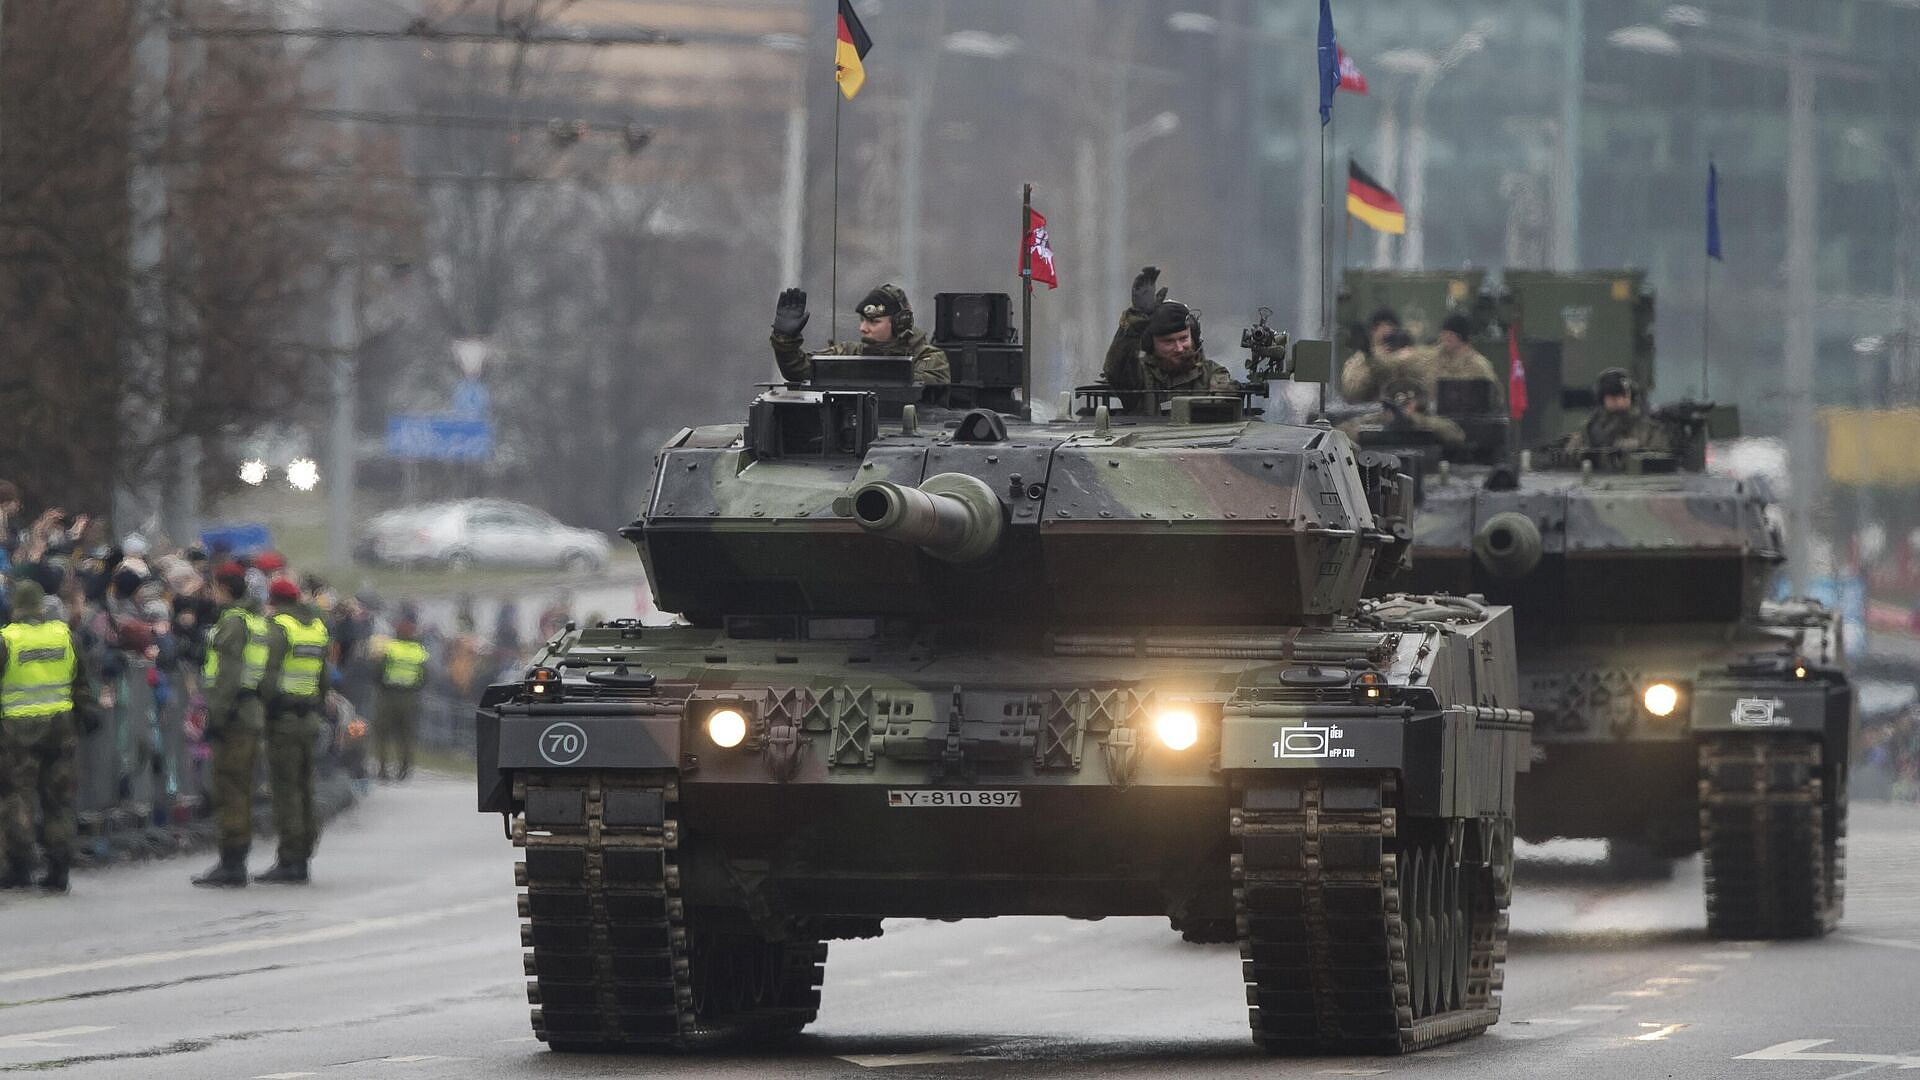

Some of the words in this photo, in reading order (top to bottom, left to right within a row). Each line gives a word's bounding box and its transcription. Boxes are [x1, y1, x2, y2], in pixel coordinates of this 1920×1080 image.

[1330, 729, 1343, 739] DEU
[548, 734, 579, 754] 70
[1272, 741, 1279, 758] 1
[1342, 748, 1355, 758] LTU
[978, 792, 1019, 805] 897
